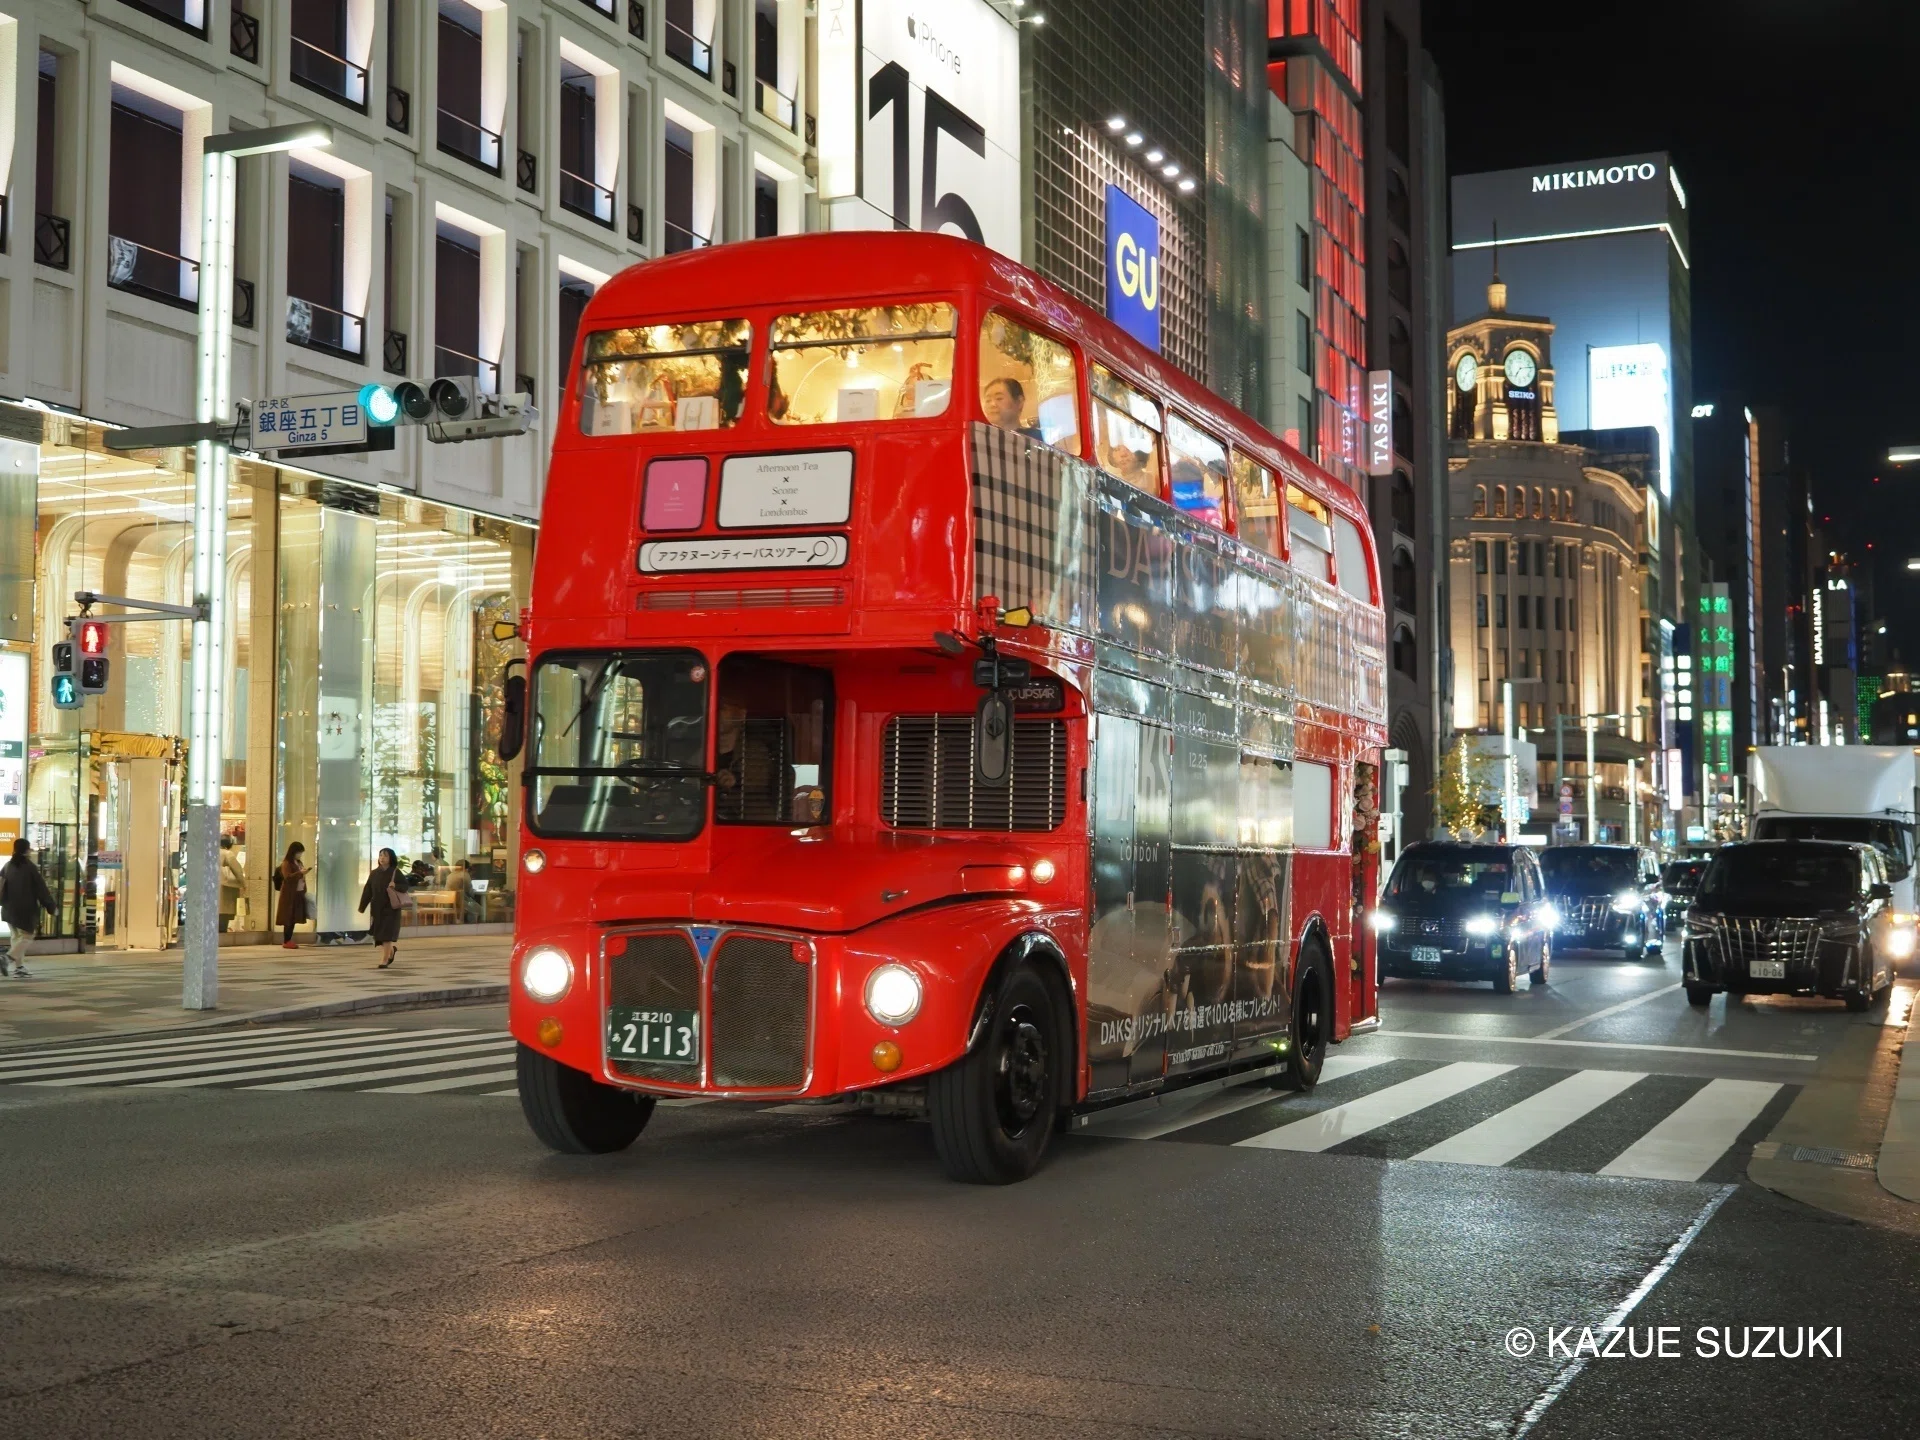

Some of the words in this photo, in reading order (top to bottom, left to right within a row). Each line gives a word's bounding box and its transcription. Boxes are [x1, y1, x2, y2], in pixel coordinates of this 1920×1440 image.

[918, 20, 961, 75] iPhone
[869, 60, 986, 246] 15
[1531, 163, 1656, 193] MIKIMOTO
[1116, 232, 1157, 311] GU
[258, 398, 290, 410] 中央区
[1508, 390, 1536, 400] SEIKO
[258, 404, 358, 433] 銀座五丁目
[1373, 382, 1389, 465] TASAKI
[288, 431, 317, 443] Ginza
[320, 429, 328, 440] 5
[756, 463, 800, 474] Afternoon
[802, 462, 819, 471] Tea
[772, 486, 799, 495] Scone
[759, 507, 808, 517] Londonbus
[658, 546, 807, 562] アフタヌーンティーバスツアー
[621, 1023, 692, 1057] 21-13
